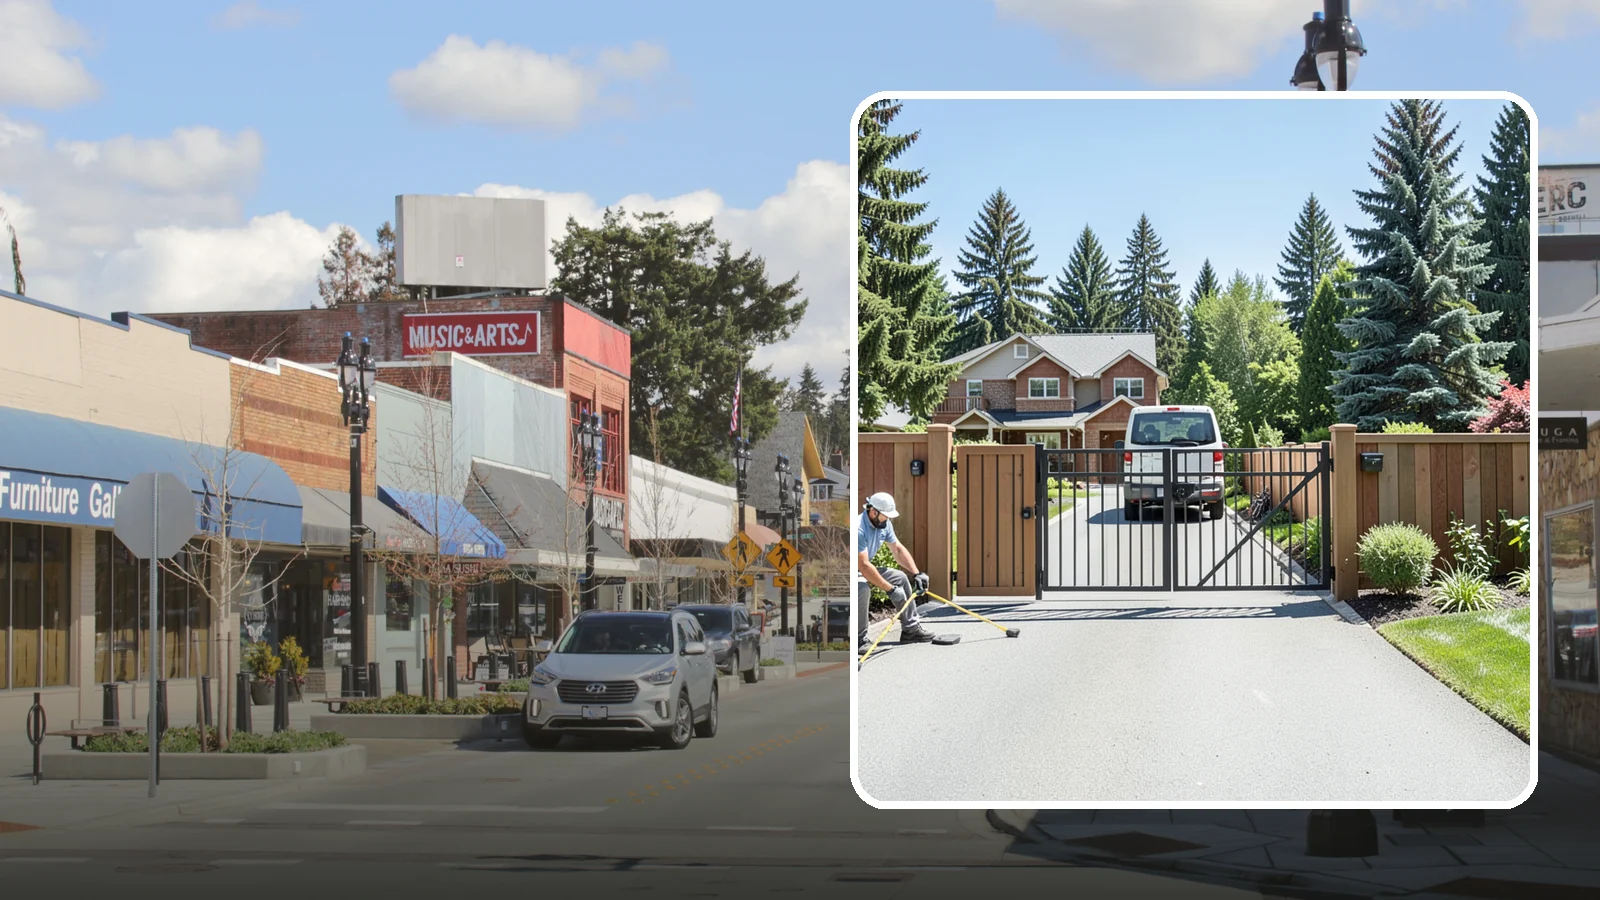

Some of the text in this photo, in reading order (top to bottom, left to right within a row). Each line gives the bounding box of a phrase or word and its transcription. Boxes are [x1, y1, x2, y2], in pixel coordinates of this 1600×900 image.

[1540, 427, 1577, 437] UGA
[0, 471, 122, 519] Furniture Gal
